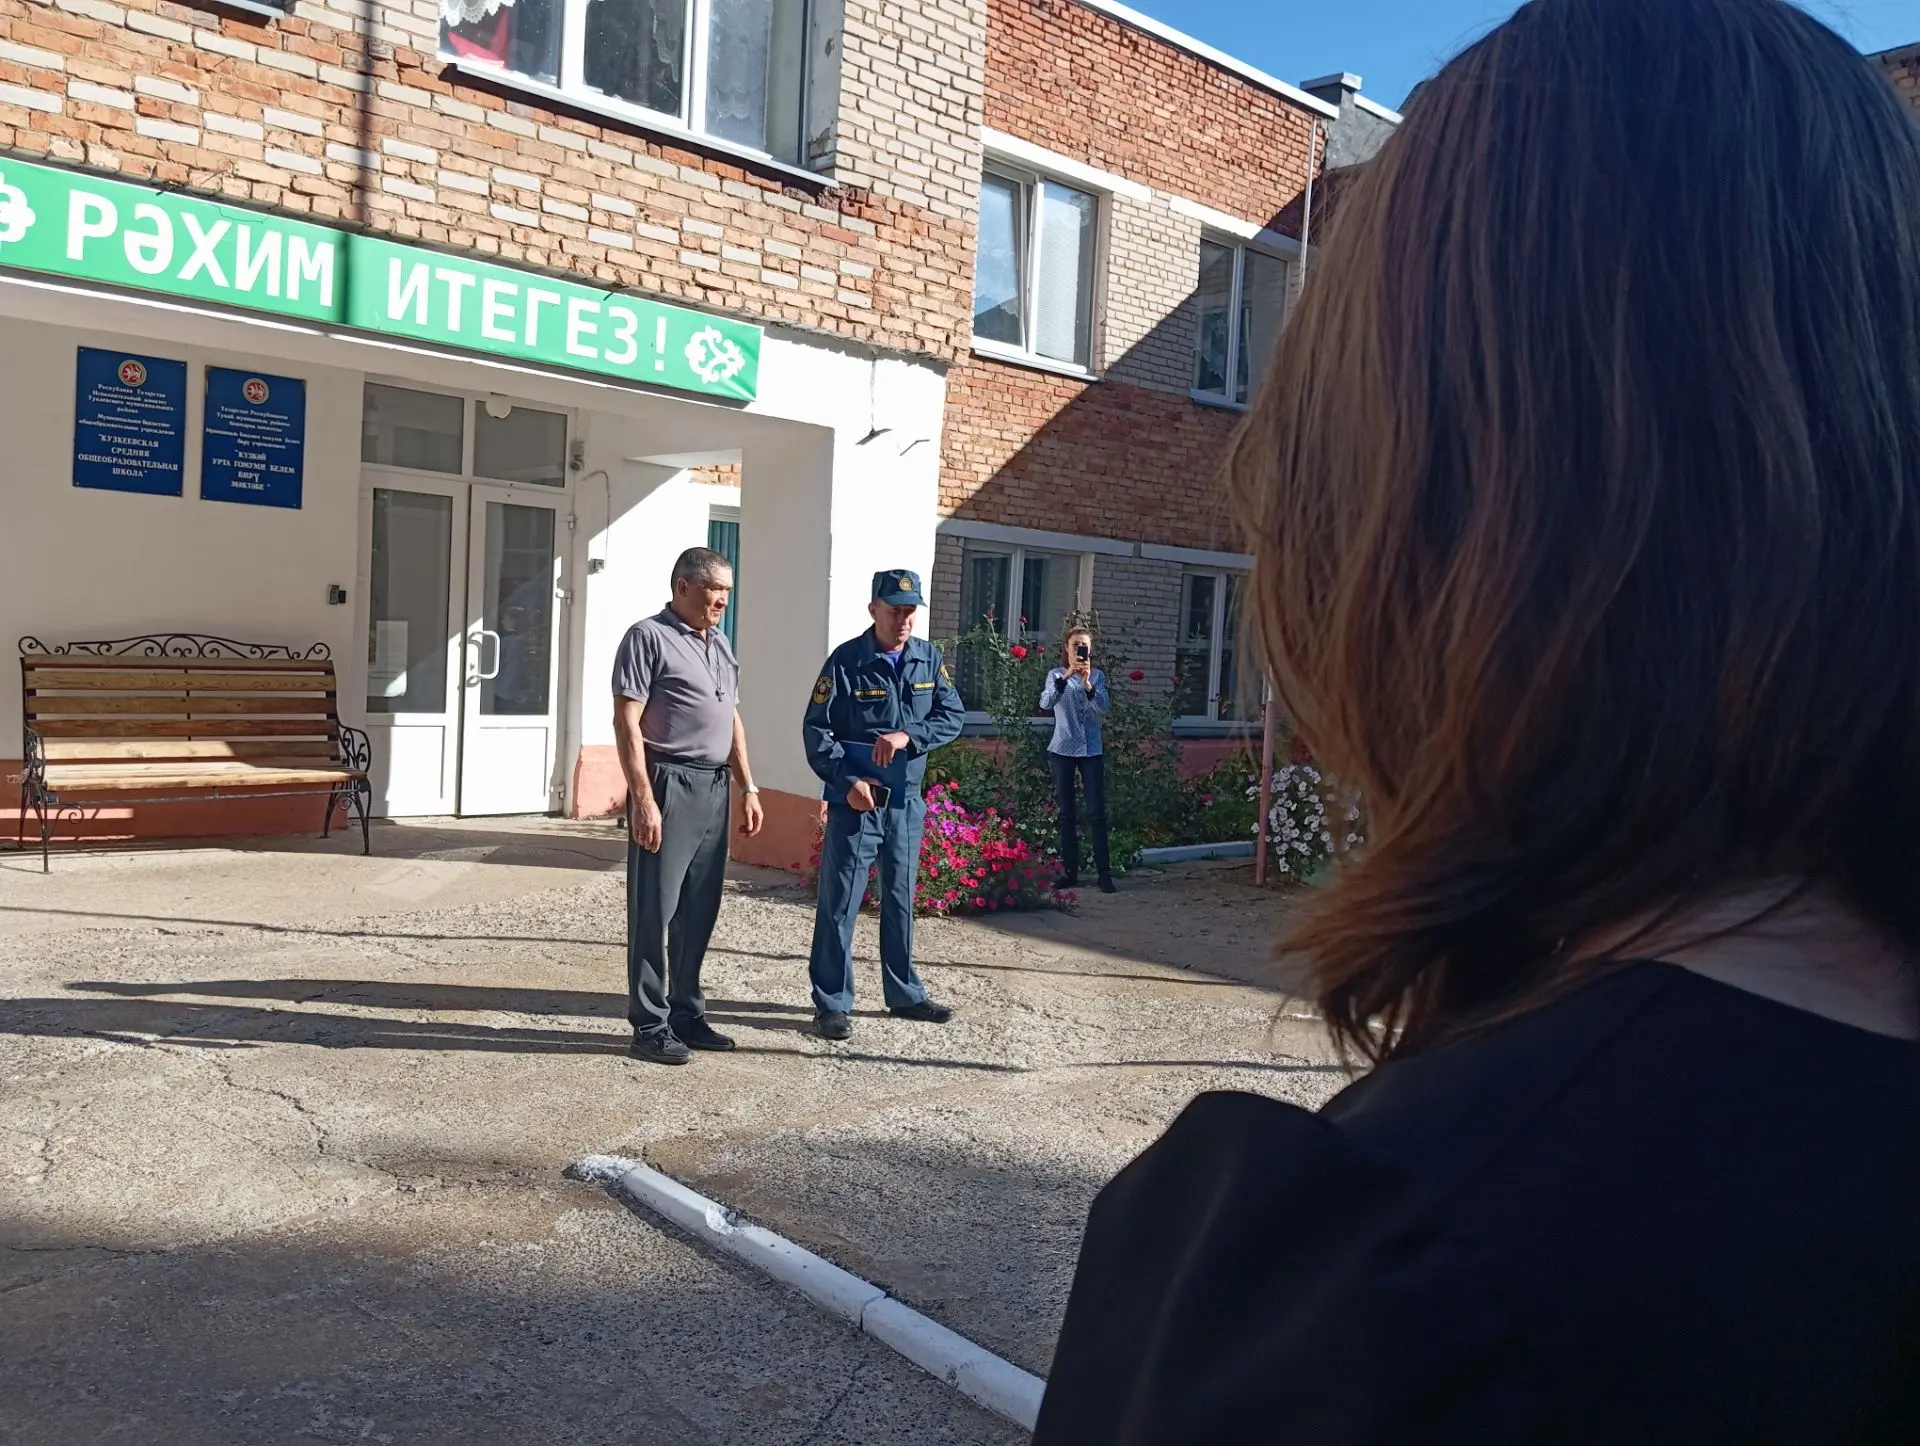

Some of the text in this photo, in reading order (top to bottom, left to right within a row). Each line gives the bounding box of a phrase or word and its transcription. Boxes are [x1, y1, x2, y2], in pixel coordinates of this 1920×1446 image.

[64, 189, 667, 372] РӘХИМ ИТЕГЕЗ!
[98, 383, 166, 398] Республика Татарстан
[111, 446, 150, 457] СРЕДНЯЯ
[78, 453, 178, 470] ОБЩЕОБРАЗОВАТЕЛЬНАЯ
[212, 458, 231, 466] УРТА
[270, 464, 295, 474] БЕЛЕМ
